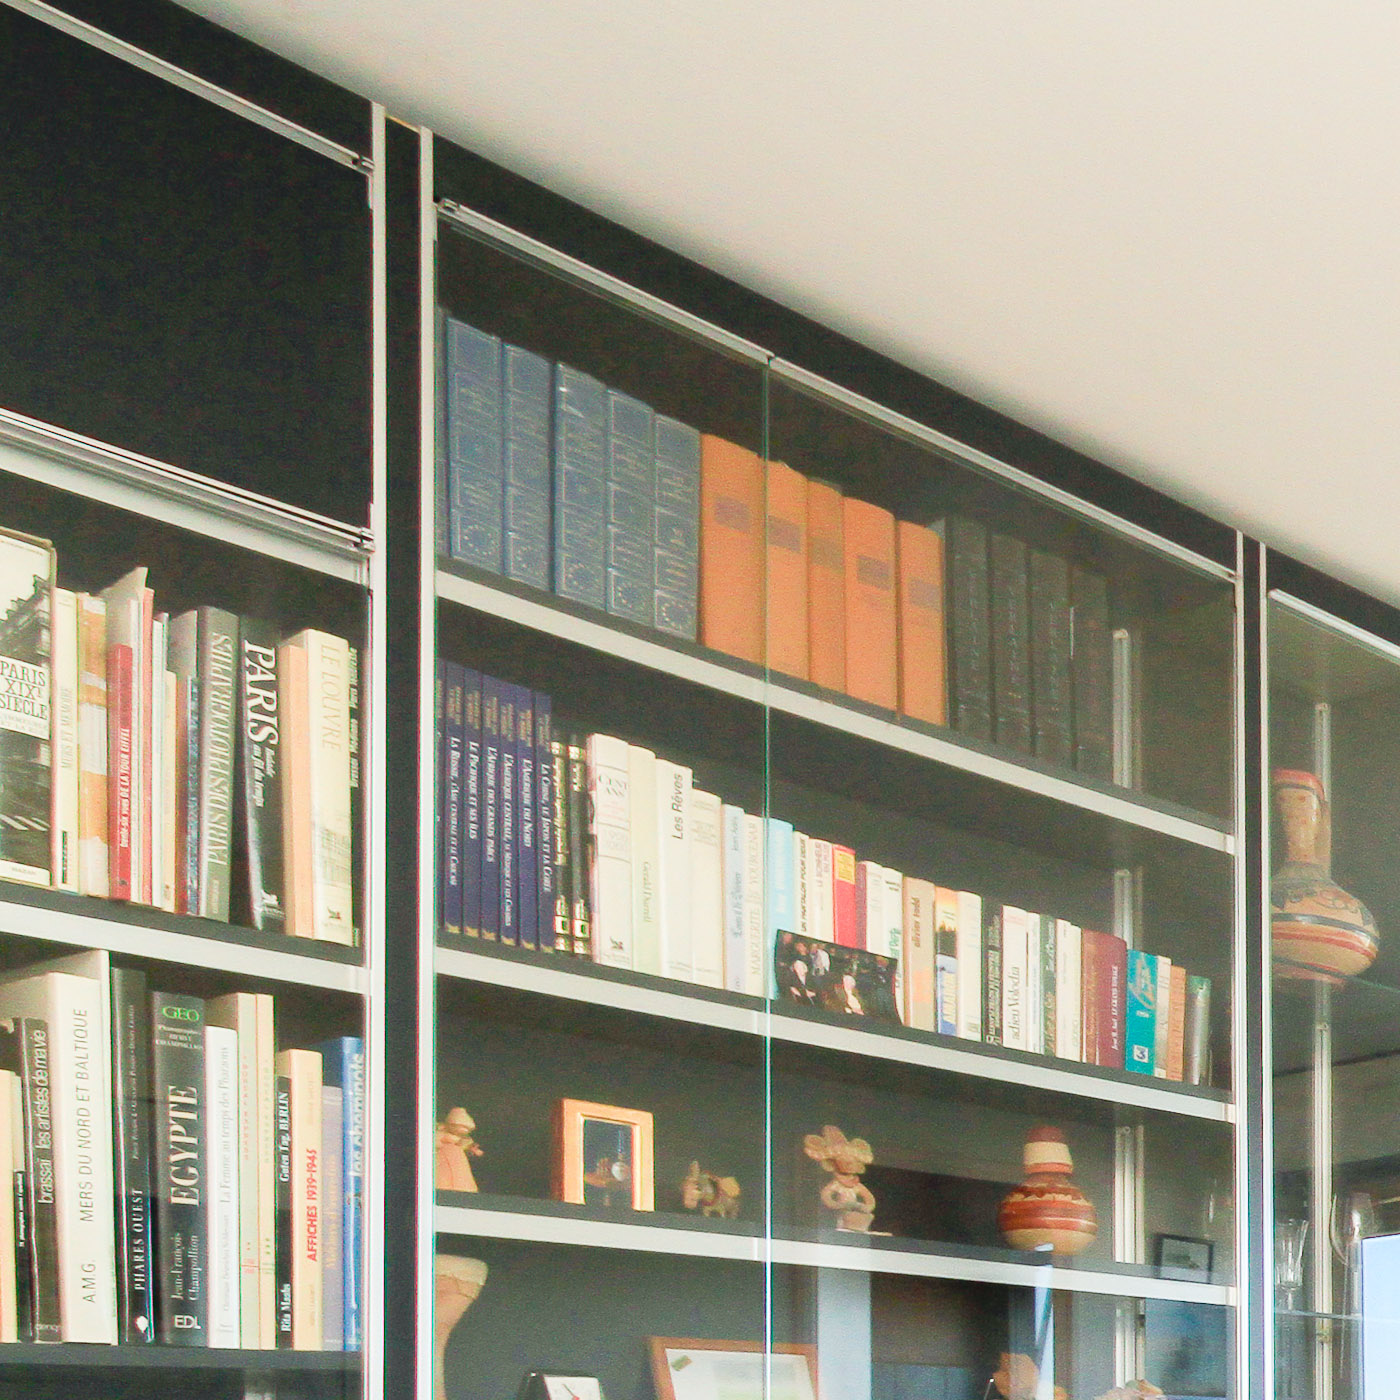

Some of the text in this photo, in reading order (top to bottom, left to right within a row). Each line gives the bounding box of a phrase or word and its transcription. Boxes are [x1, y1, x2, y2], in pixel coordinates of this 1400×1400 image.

[0, 661, 46, 687] PARIS
[244, 639, 279, 745] PARIS
[0, 694, 48, 721] SIECLE
[208, 631, 234, 774] PHOTOGRAPHES
[321, 645, 341, 752] LE LOUVRE
[119, 753, 130, 775] TOUR
[119, 775, 130, 787] LA
[541, 764, 551, 775] LA
[207, 775, 230, 811] DES
[252, 781, 264, 808] temps
[670, 773, 684, 840] Les Rêves
[207, 813, 229, 865] PARIS
[523, 822, 534, 848] NORD
[541, 817, 552, 842] JAPON
[542, 854, 552, 864] LA
[911, 897, 920, 918] todd
[750, 908, 761, 976] MARGUERITE
[162, 1006, 200, 1021] GEO
[1007, 966, 1021, 1041] adieu Volodia
[218, 1046, 230, 1090] Pharaons
[33, 1028, 54, 1204] brassaï les artistes de ma vie
[219, 1091, 230, 1109] des
[278, 1091, 289, 1131] BERLIN
[219, 1110, 233, 1138] temps
[72, 1008, 97, 1304] A.M.G. MERS DU NORD ET BALTIQUE
[168, 1085, 201, 1208] EGYPTE
[221, 1139, 230, 1152] au
[219, 1154, 231, 1190] Femme
[279, 1155, 290, 1182] Guten
[219, 1192, 231, 1204] La
[306, 1148, 318, 1263] AFFICHES 1939-1945
[132, 1188, 145, 1291] PHARES OUEST
[170, 1232, 185, 1300] Jean-François
[188, 1235, 203, 1301] Champollion
[280, 1313, 291, 1332] Rita
